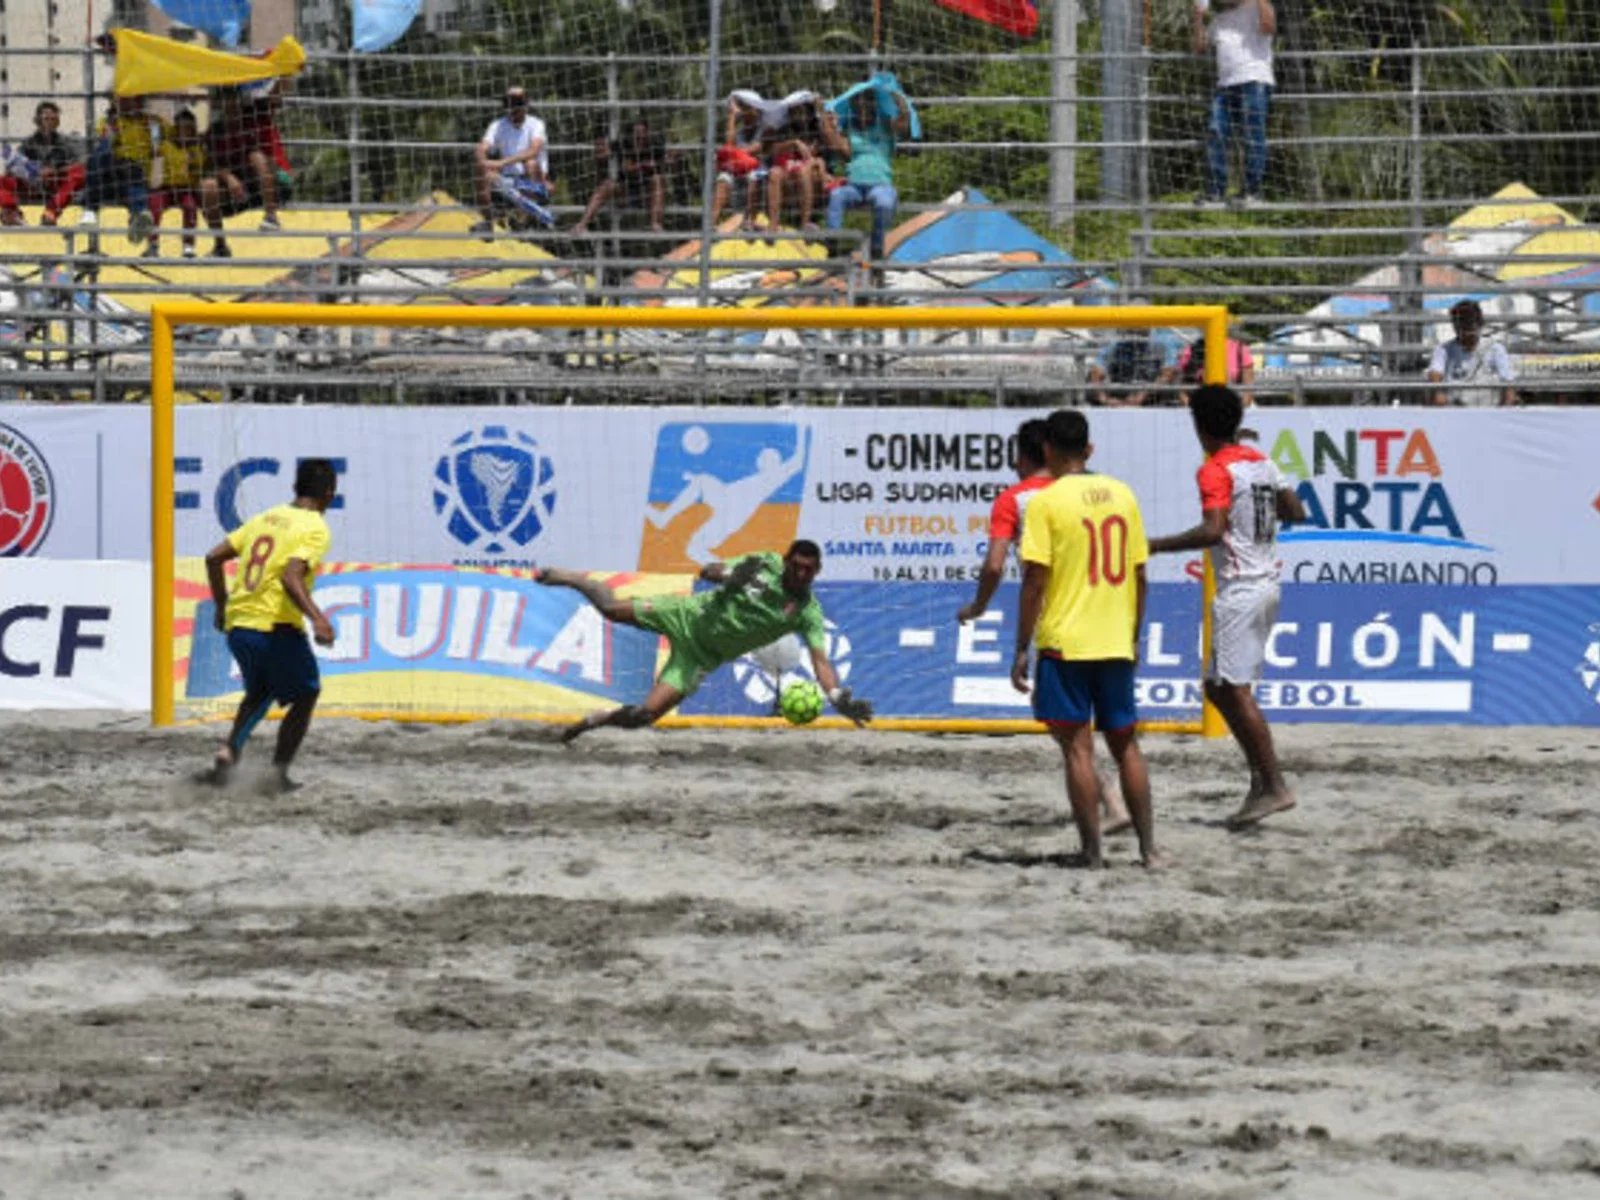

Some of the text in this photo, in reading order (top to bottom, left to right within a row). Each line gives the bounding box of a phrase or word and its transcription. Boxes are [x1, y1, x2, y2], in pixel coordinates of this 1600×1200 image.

[1270, 429, 1442, 480] ANTA
[817, 482, 874, 503] LIGA
[1279, 480, 1466, 540] ARTA
[244, 535, 275, 592] 8
[824, 541, 887, 557] SANTA
[892, 541, 955, 557] MARTA
[896, 566, 918, 581] AL
[919, 566, 939, 581] 21
[944, 566, 966, 581] DE
[1082, 514, 1128, 588] 10
[1293, 561, 1498, 585] CAMBIANDO
[0, 604, 111, 678] CF
[229, 584, 613, 687] GUILA
